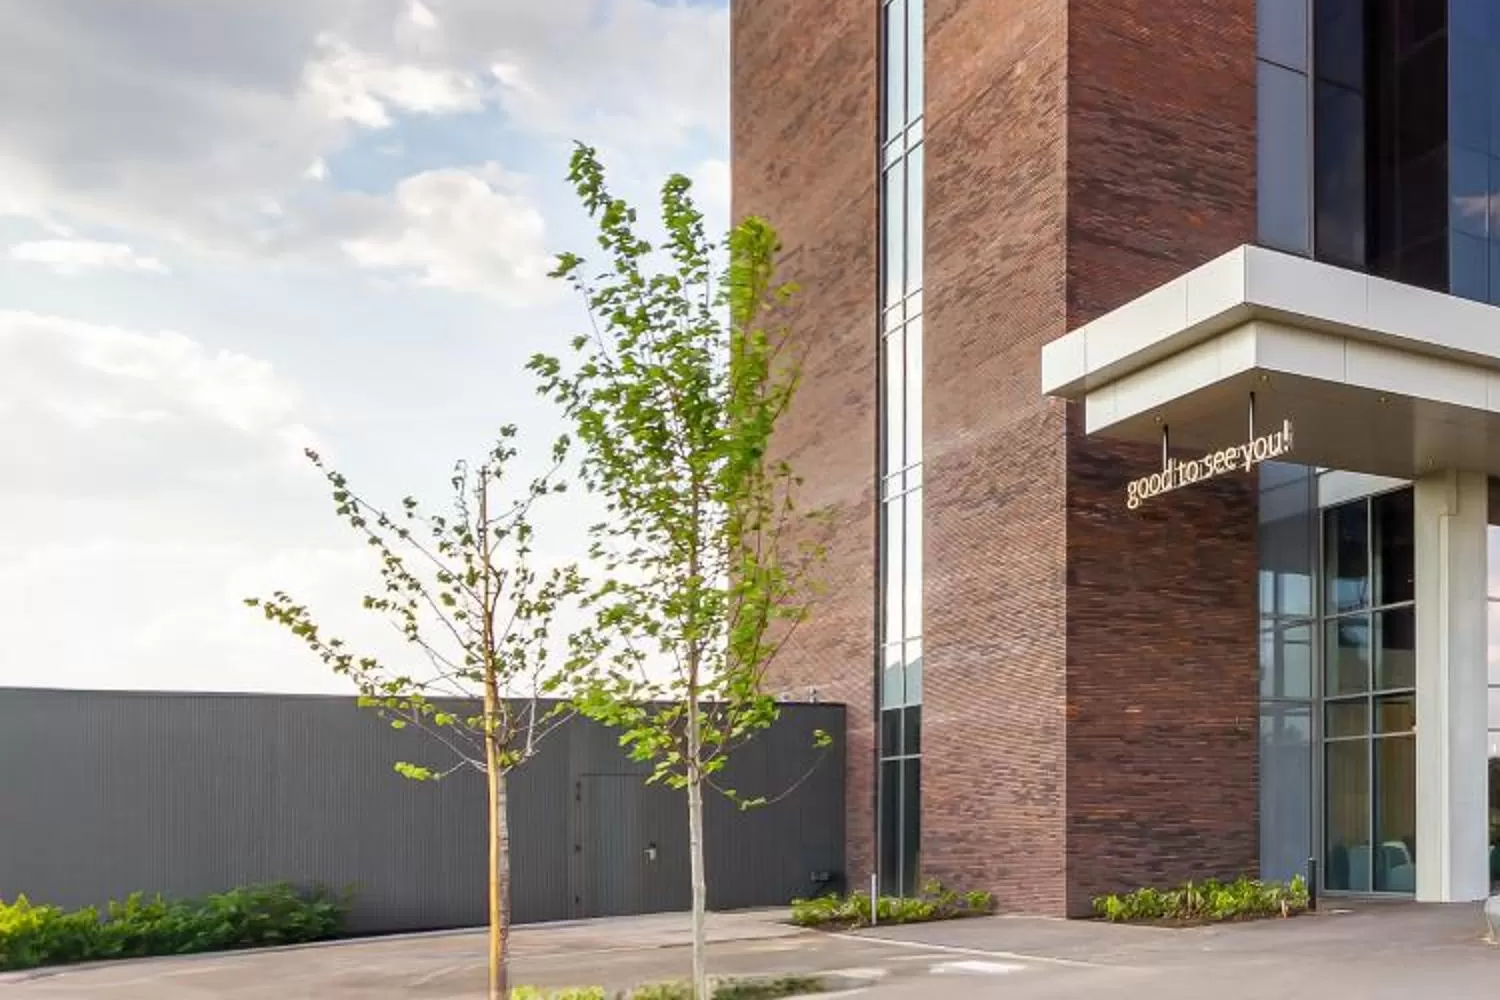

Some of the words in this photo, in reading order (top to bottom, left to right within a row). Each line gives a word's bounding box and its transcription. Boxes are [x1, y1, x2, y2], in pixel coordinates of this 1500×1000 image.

[1127, 458, 1174, 509] good
[1177, 461, 1199, 486] to
[1205, 446, 1237, 478] see
[1241, 419, 1290, 472] you!
